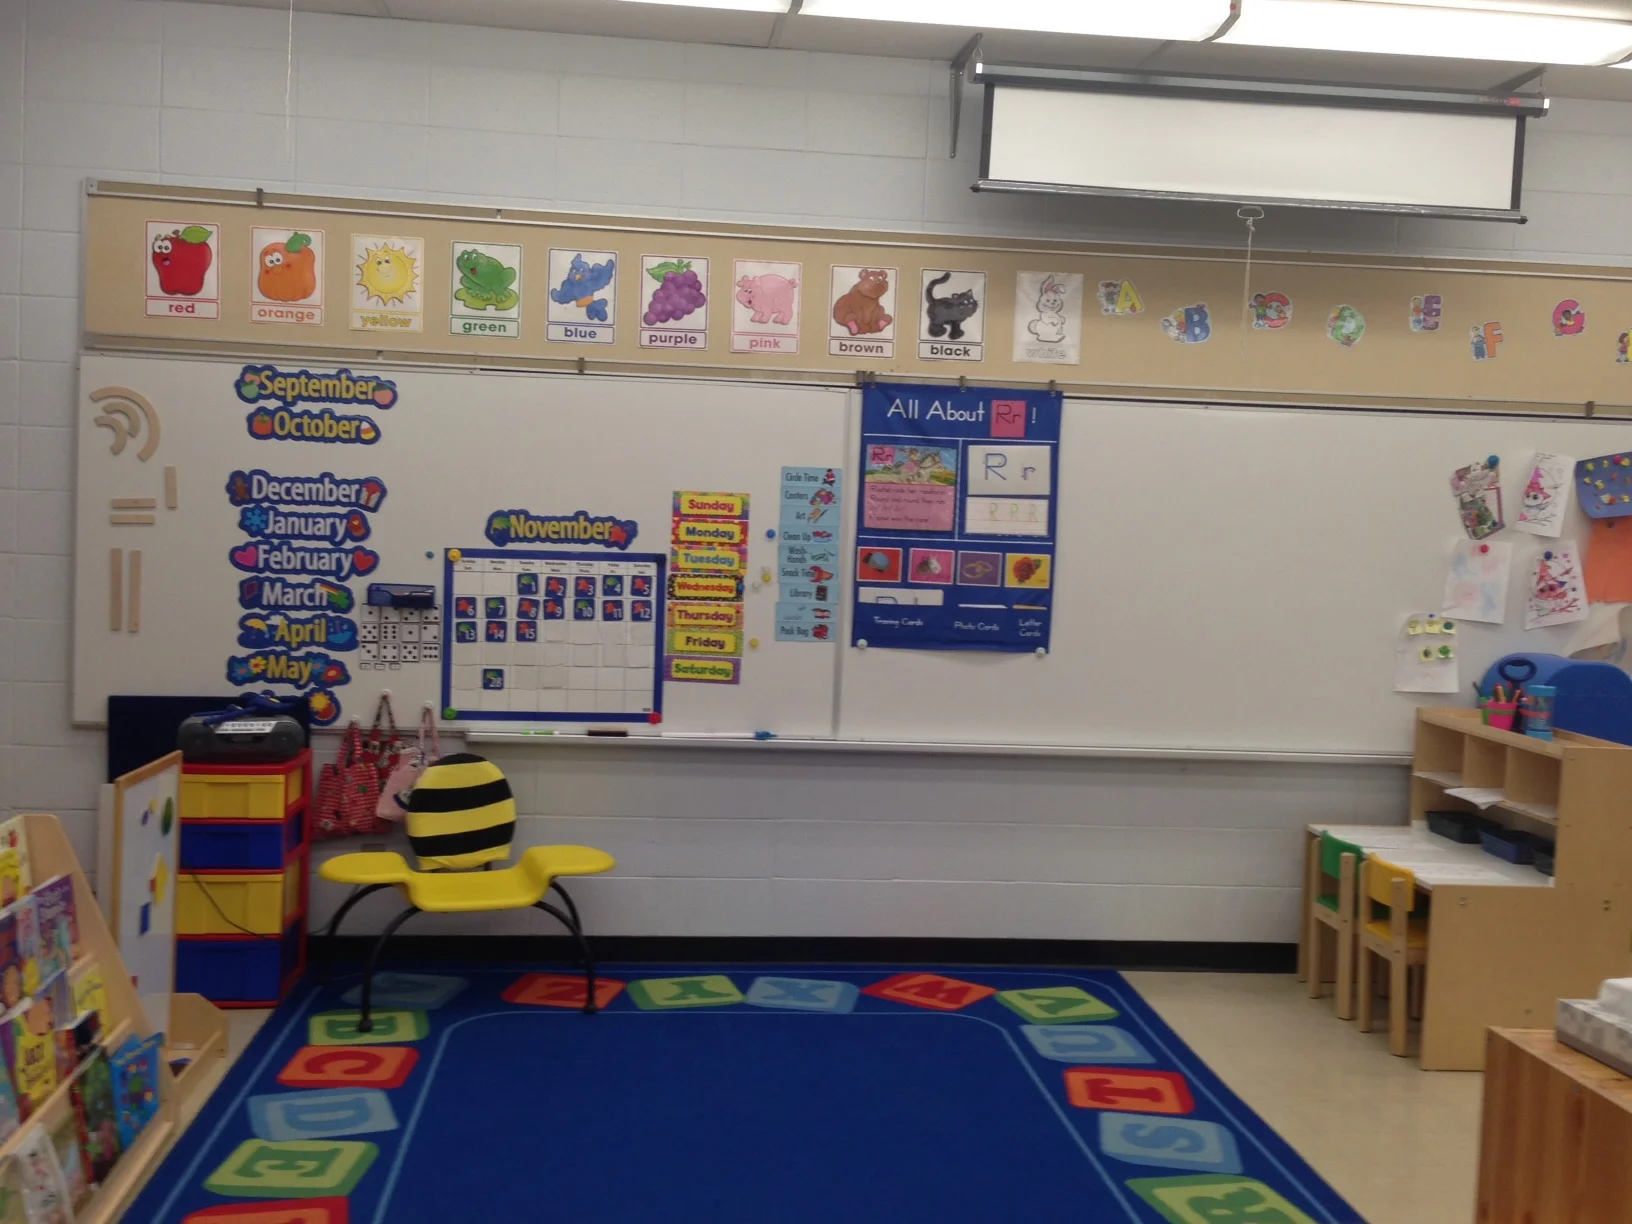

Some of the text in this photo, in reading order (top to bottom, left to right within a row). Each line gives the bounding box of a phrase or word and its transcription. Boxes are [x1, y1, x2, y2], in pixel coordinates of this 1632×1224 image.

[168, 302, 196, 314] red
[258, 307, 315, 323] orange
[359, 312, 412, 328] yellow
[1552, 298, 1586, 335] G
[462, 320, 507, 335] green
[564, 326, 598, 339] blue
[649, 333, 698, 347] purple
[749, 337, 781, 349] pink
[838, 341, 884, 354] brown
[930, 344, 971, 357] black
[1025, 347, 1067, 360] white
[259, 370, 377, 402] September
[886, 399, 919, 420] All
[925, 400, 985, 422] About
[995, 403, 1022, 424] Rr
[273, 411, 360, 439] October
[984, 452, 1037, 481] R r
[785, 472, 819, 482] Circle Time
[252, 474, 361, 503] December
[785, 490, 809, 500] Centers
[688, 498, 735, 513] Sunday
[796, 511, 806, 520] Art
[264, 509, 348, 542] January
[509, 515, 613, 540] November
[685, 526, 735, 541] Monday
[783, 531, 812, 542] Clean Up
[257, 544, 354, 578] February
[683, 552, 735, 568] Tuesday
[781, 567, 799, 577] Snack
[261, 581, 329, 606] March
[557, 586, 564, 596] 2
[587, 585, 594, 595] 3
[614, 584, 622, 594] 4
[677, 581, 734, 593] Wednesday
[789, 588, 813, 599] Library
[467, 605, 475, 616] 6
[498, 605, 504, 615] 7
[582, 606, 593, 617] 10
[613, 608, 622, 618] 11
[677, 609, 734, 624] Thursday
[274, 619, 327, 648] April
[465, 630, 476, 640] 13
[525, 629, 536, 639] 15
[685, 635, 726, 650] Friday
[266, 654, 313, 684] May
[674, 663, 732, 678] Saturday
[764, 982, 836, 1003] X
[304, 1050, 385, 1075] C
[1084, 1077, 1165, 1105] T
[281, 1096, 373, 1132] D
[1119, 1122, 1206, 1153] S
[234, 1145, 346, 1179] E
